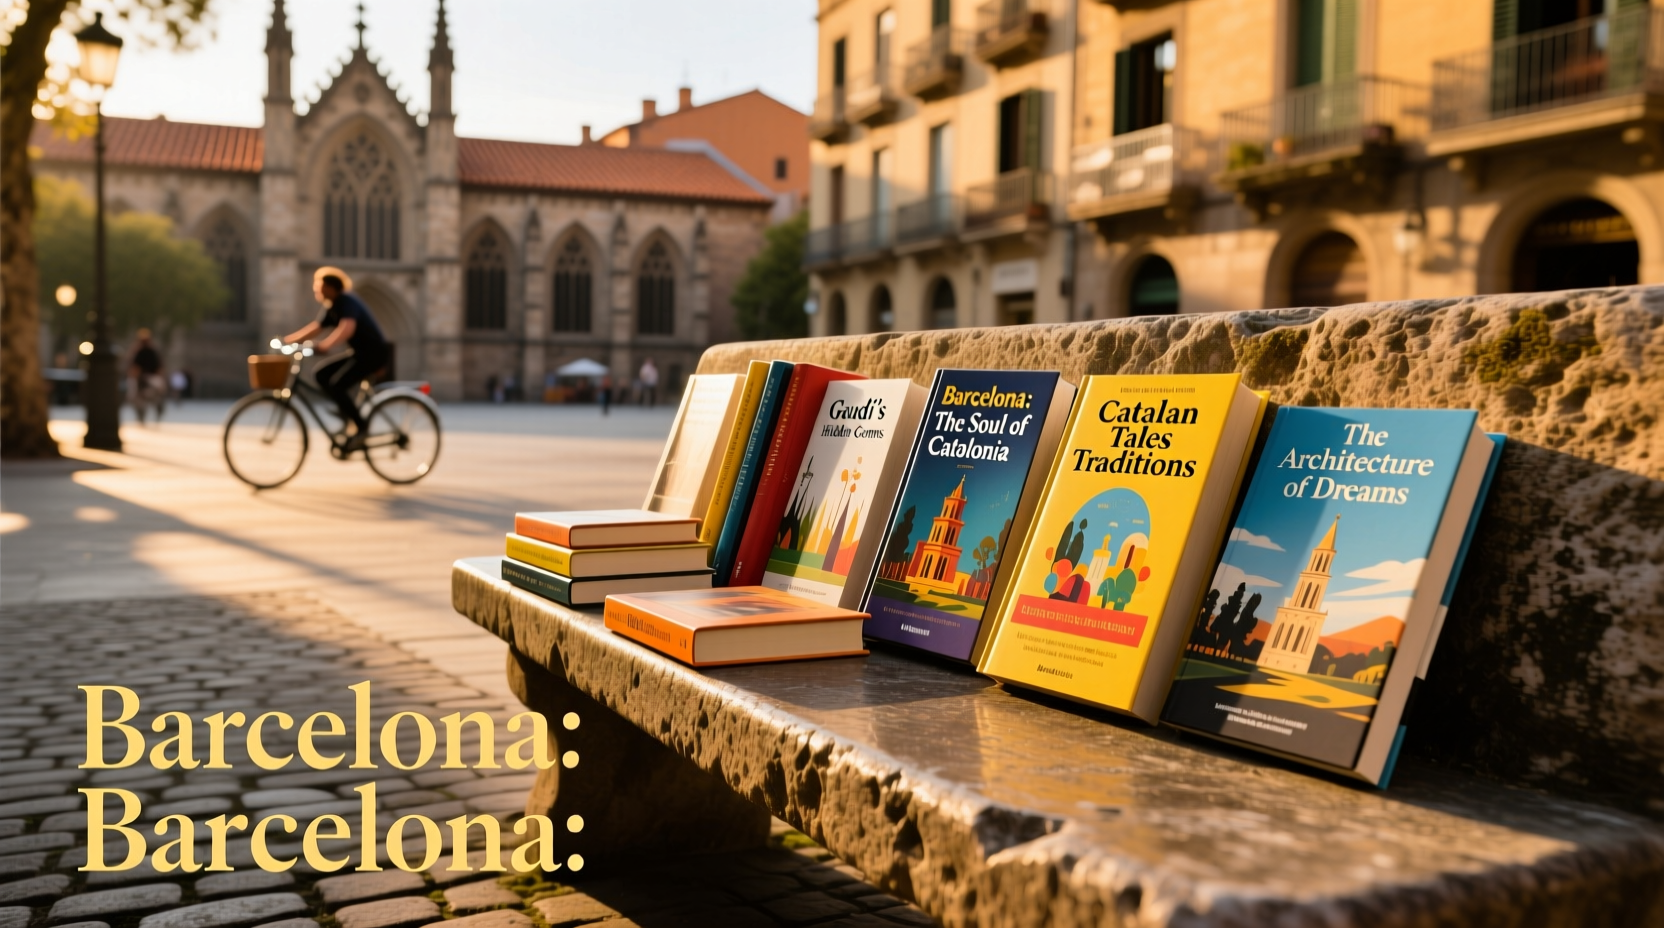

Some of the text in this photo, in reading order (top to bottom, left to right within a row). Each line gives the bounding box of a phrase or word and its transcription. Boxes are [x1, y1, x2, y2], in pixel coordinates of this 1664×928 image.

[941, 385, 1033, 409] Barcelona:
[935, 411, 1033, 436] The Soul of
[1098, 399, 1198, 424] Catalan
[1110, 425, 1173, 449] Tales
[1343, 423, 1389, 447] The
[1073, 448, 1197, 478] Traditions
[1277, 447, 1434, 476] Architecture
[1283, 475, 1410, 505] of Dreams
